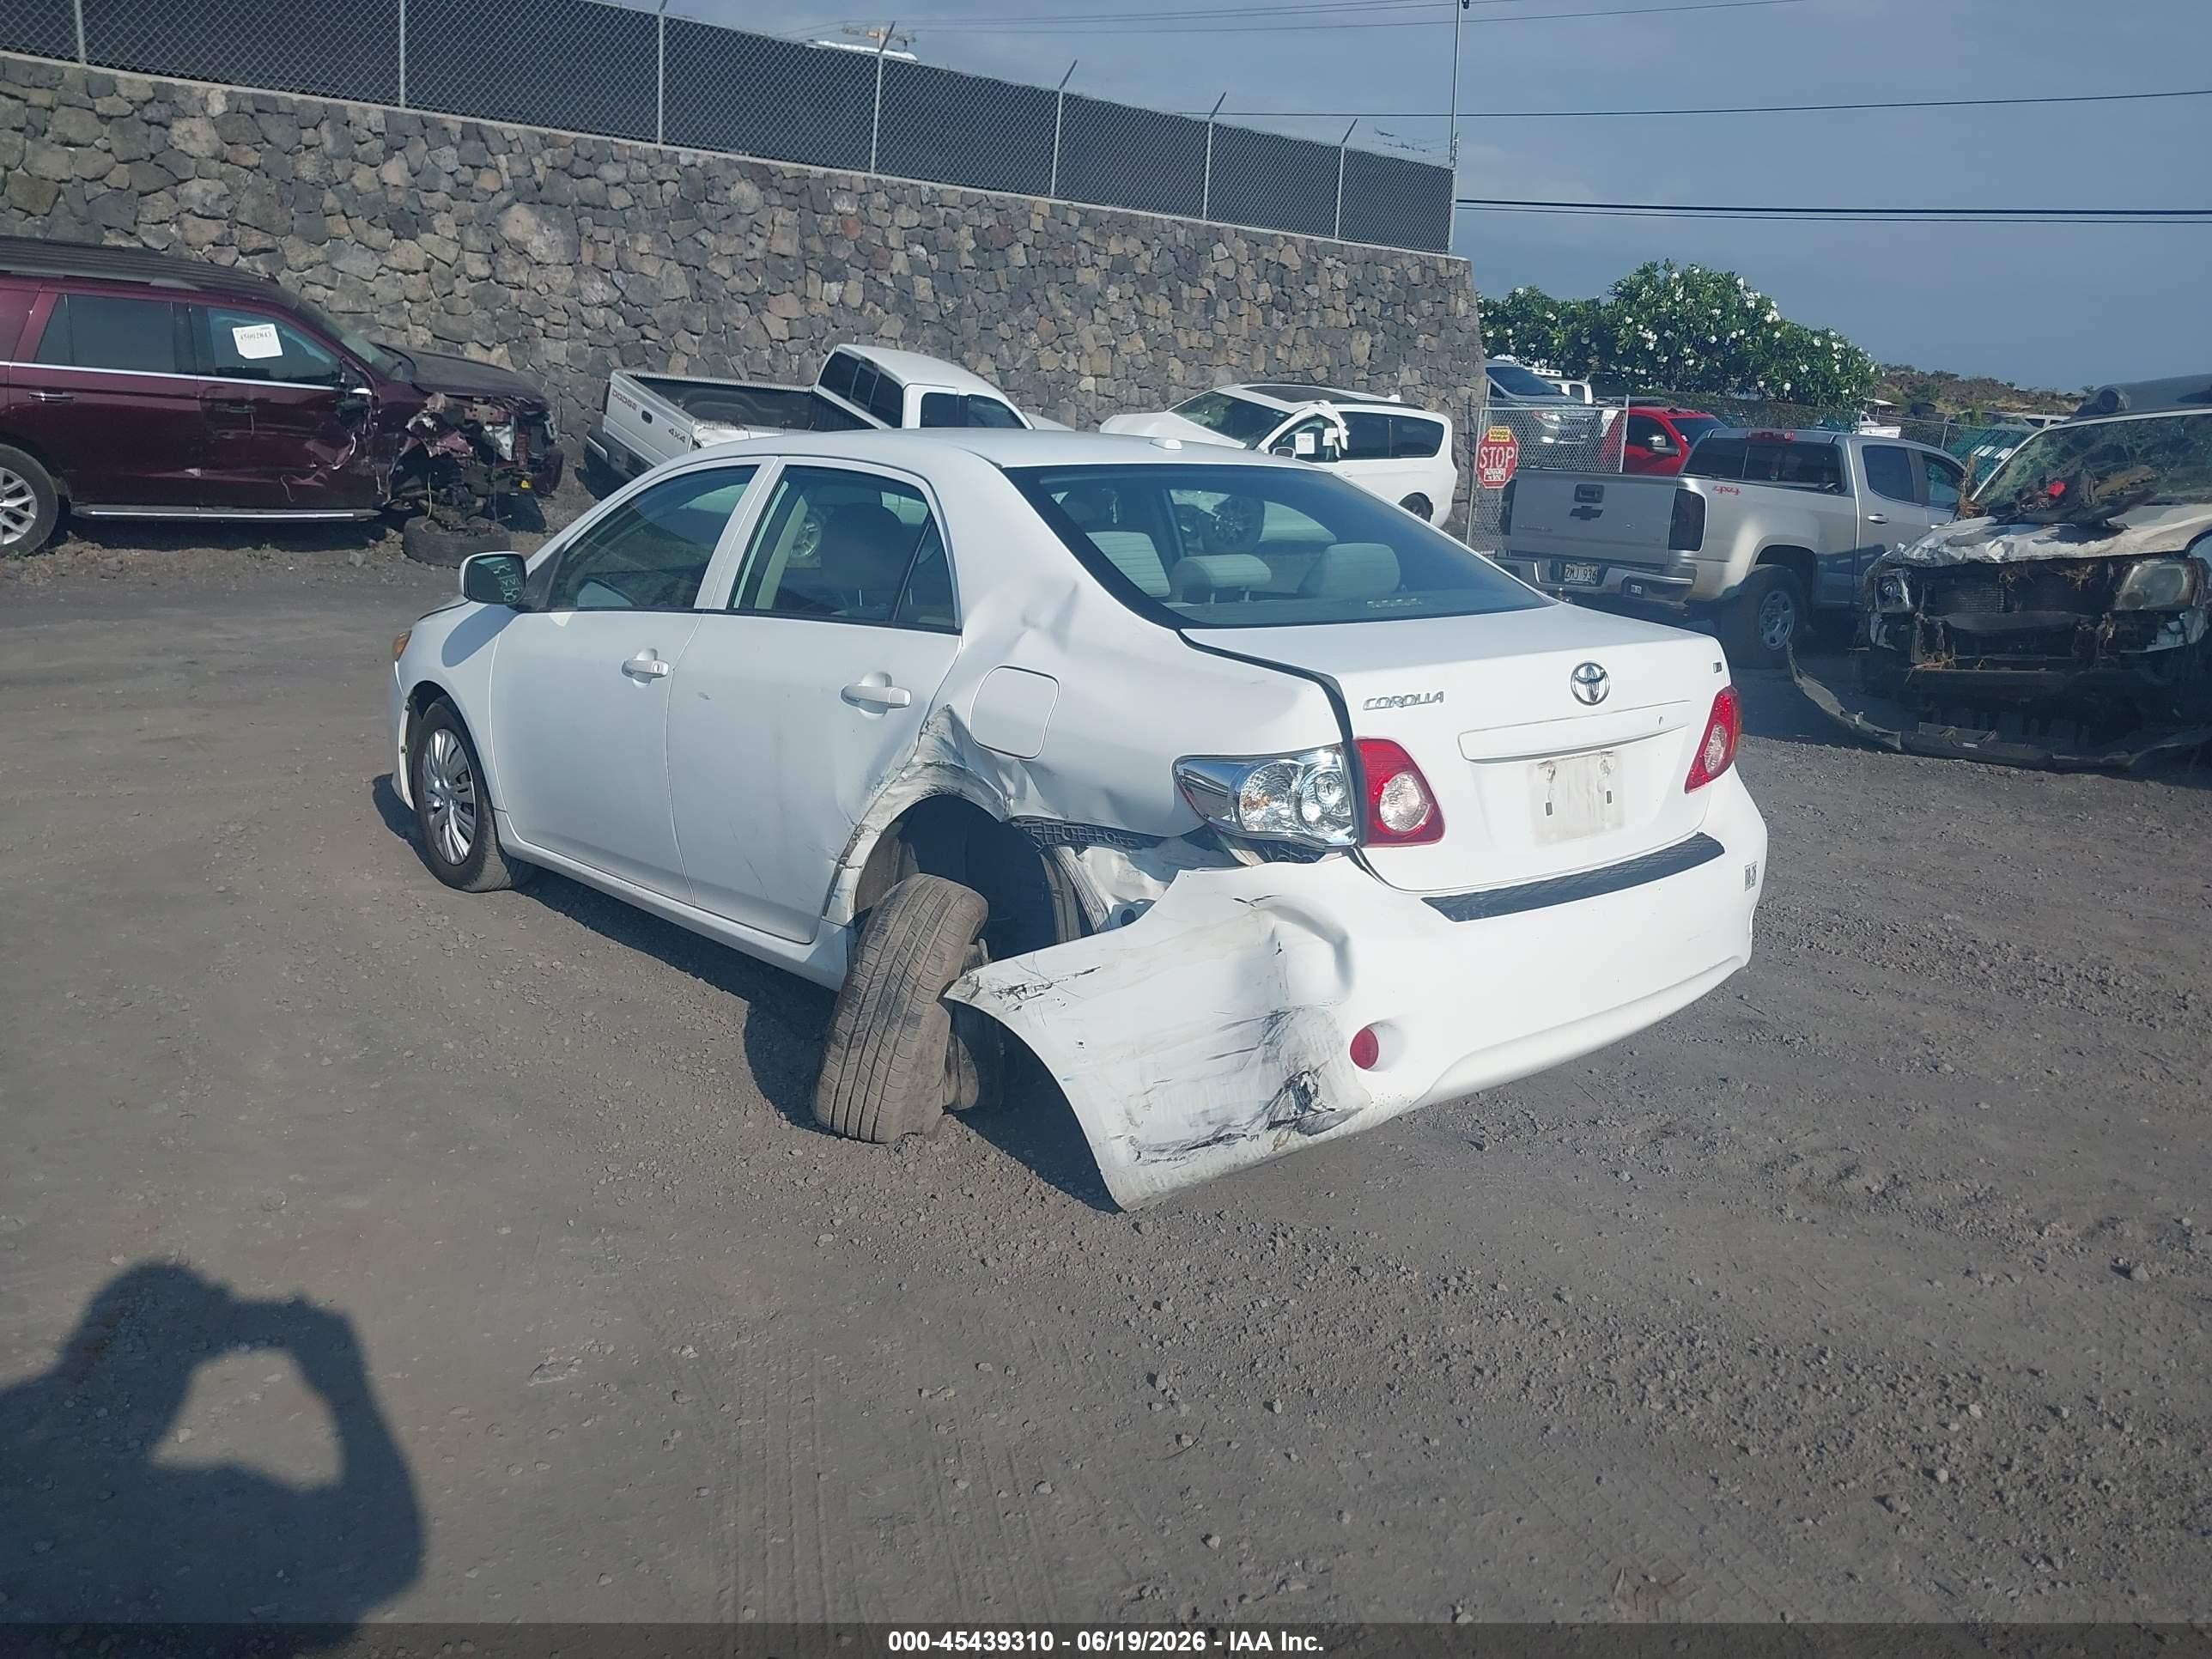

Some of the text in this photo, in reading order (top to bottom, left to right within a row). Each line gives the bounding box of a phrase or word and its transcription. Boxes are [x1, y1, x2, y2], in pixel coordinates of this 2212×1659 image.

[612, 389, 638, 411] DODGE
[1479, 446, 1515, 469] STOP
[1363, 690, 1444, 711] COROLLA
